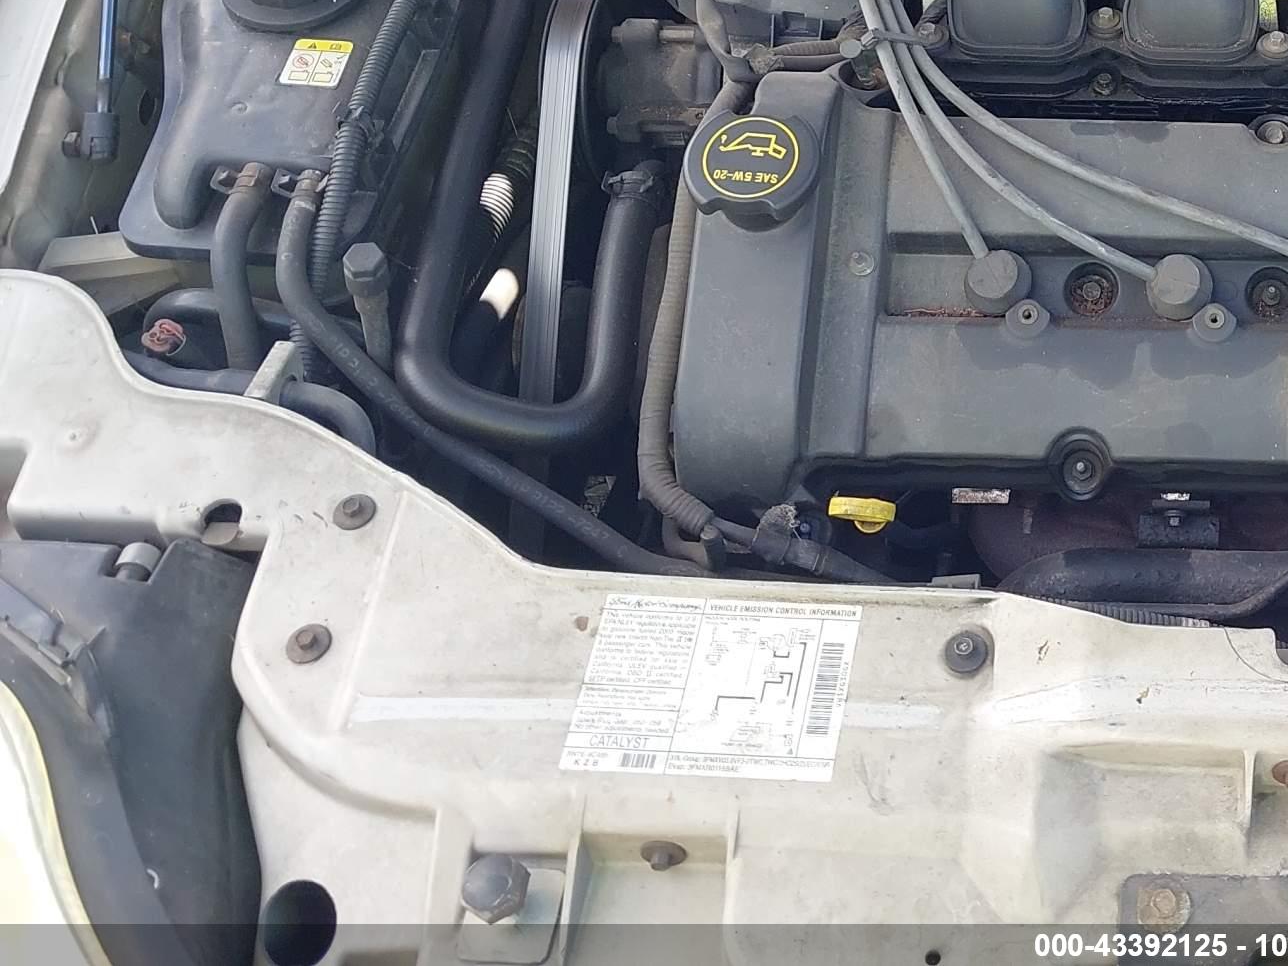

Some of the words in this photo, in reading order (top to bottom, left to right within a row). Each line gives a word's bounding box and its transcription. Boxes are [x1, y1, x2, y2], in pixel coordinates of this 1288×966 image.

[713, 169, 752, 182] 5W-20
[755, 172, 778, 184] SAE
[775, 607, 807, 615] CONTROL
[809, 608, 857, 617] INFORMATION
[589, 735, 650, 748] CATALYST
